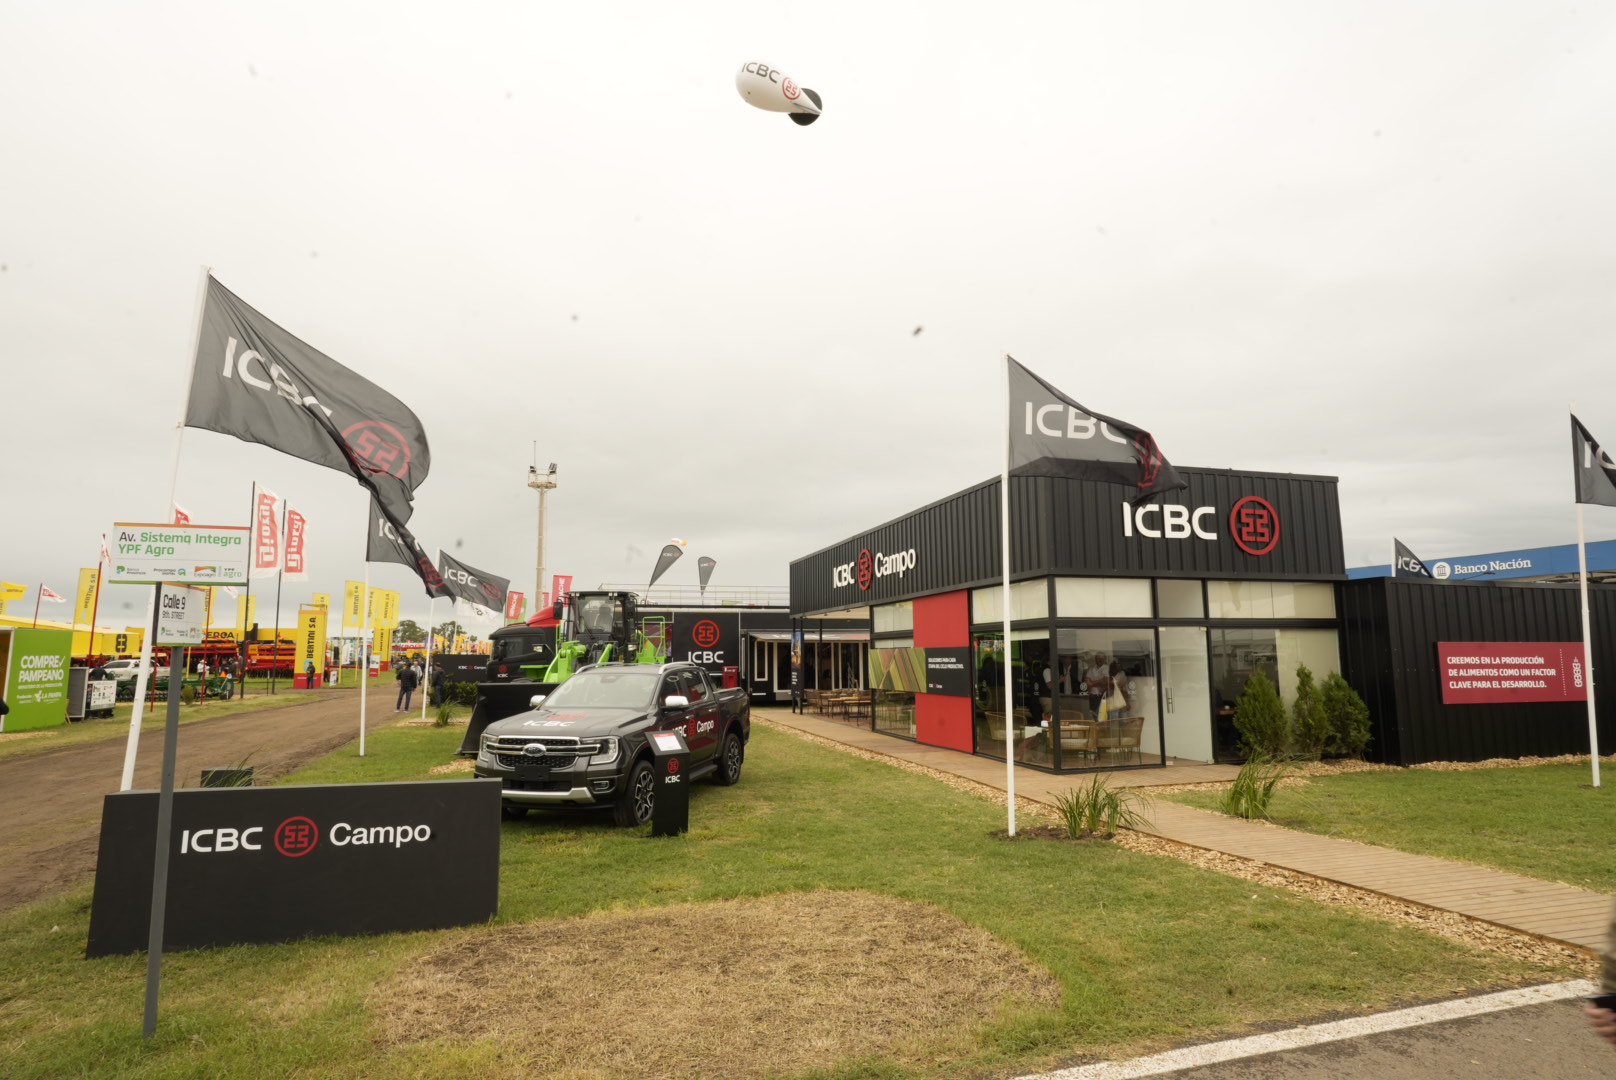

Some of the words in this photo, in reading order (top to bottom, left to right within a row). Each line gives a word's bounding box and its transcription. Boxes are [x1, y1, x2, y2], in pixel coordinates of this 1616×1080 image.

[741, 61, 780, 84] ICBC
[1122, 501, 1218, 541] ICBC
[119, 531, 136, 542] Av.
[140, 531, 191, 545] Sistema
[195, 533, 242, 547] Integra
[118, 543, 142, 555] YPF
[144, 544, 175, 557] Agro
[833, 561, 855, 588] ICBC
[874, 548, 917, 579] Campo
[1453, 564, 1488, 575] Banco
[1489, 557, 1532, 572] Nación
[223, 570, 242, 579] agro
[444, 566, 479, 587] ICBC
[163, 594, 180, 609] Calle
[181, 596, 186, 610] 9
[306, 627, 315, 659] BERTINI
[21, 655, 59, 669] COMPRE
[687, 651, 724, 664] ICBC
[1447, 656, 1480, 665] CREEMOS
[1481, 656, 1491, 665] EN
[1491, 656, 1500, 665] LA
[1501, 655, 1544, 665] PRODUCCIÓN
[18, 669, 64, 682] PAMPEANO
[1448, 669, 1458, 677] DE
[1459, 668, 1499, 677] ALIMENTOS
[1499, 668, 1519, 677] COMO
[1520, 668, 1530, 677] UN
[1531, 668, 1556, 677] FACTOR
[1449, 680, 1472, 689] CLAVE
[1472, 680, 1492, 689] PARA
[1492, 680, 1501, 689] EL
[1501, 680, 1547, 689] DESARROLLO.
[696, 719, 714, 734] Campo
[665, 774, 681, 784] ICBC
[180, 826, 263, 854] ICBC
[329, 822, 432, 848] Campo
